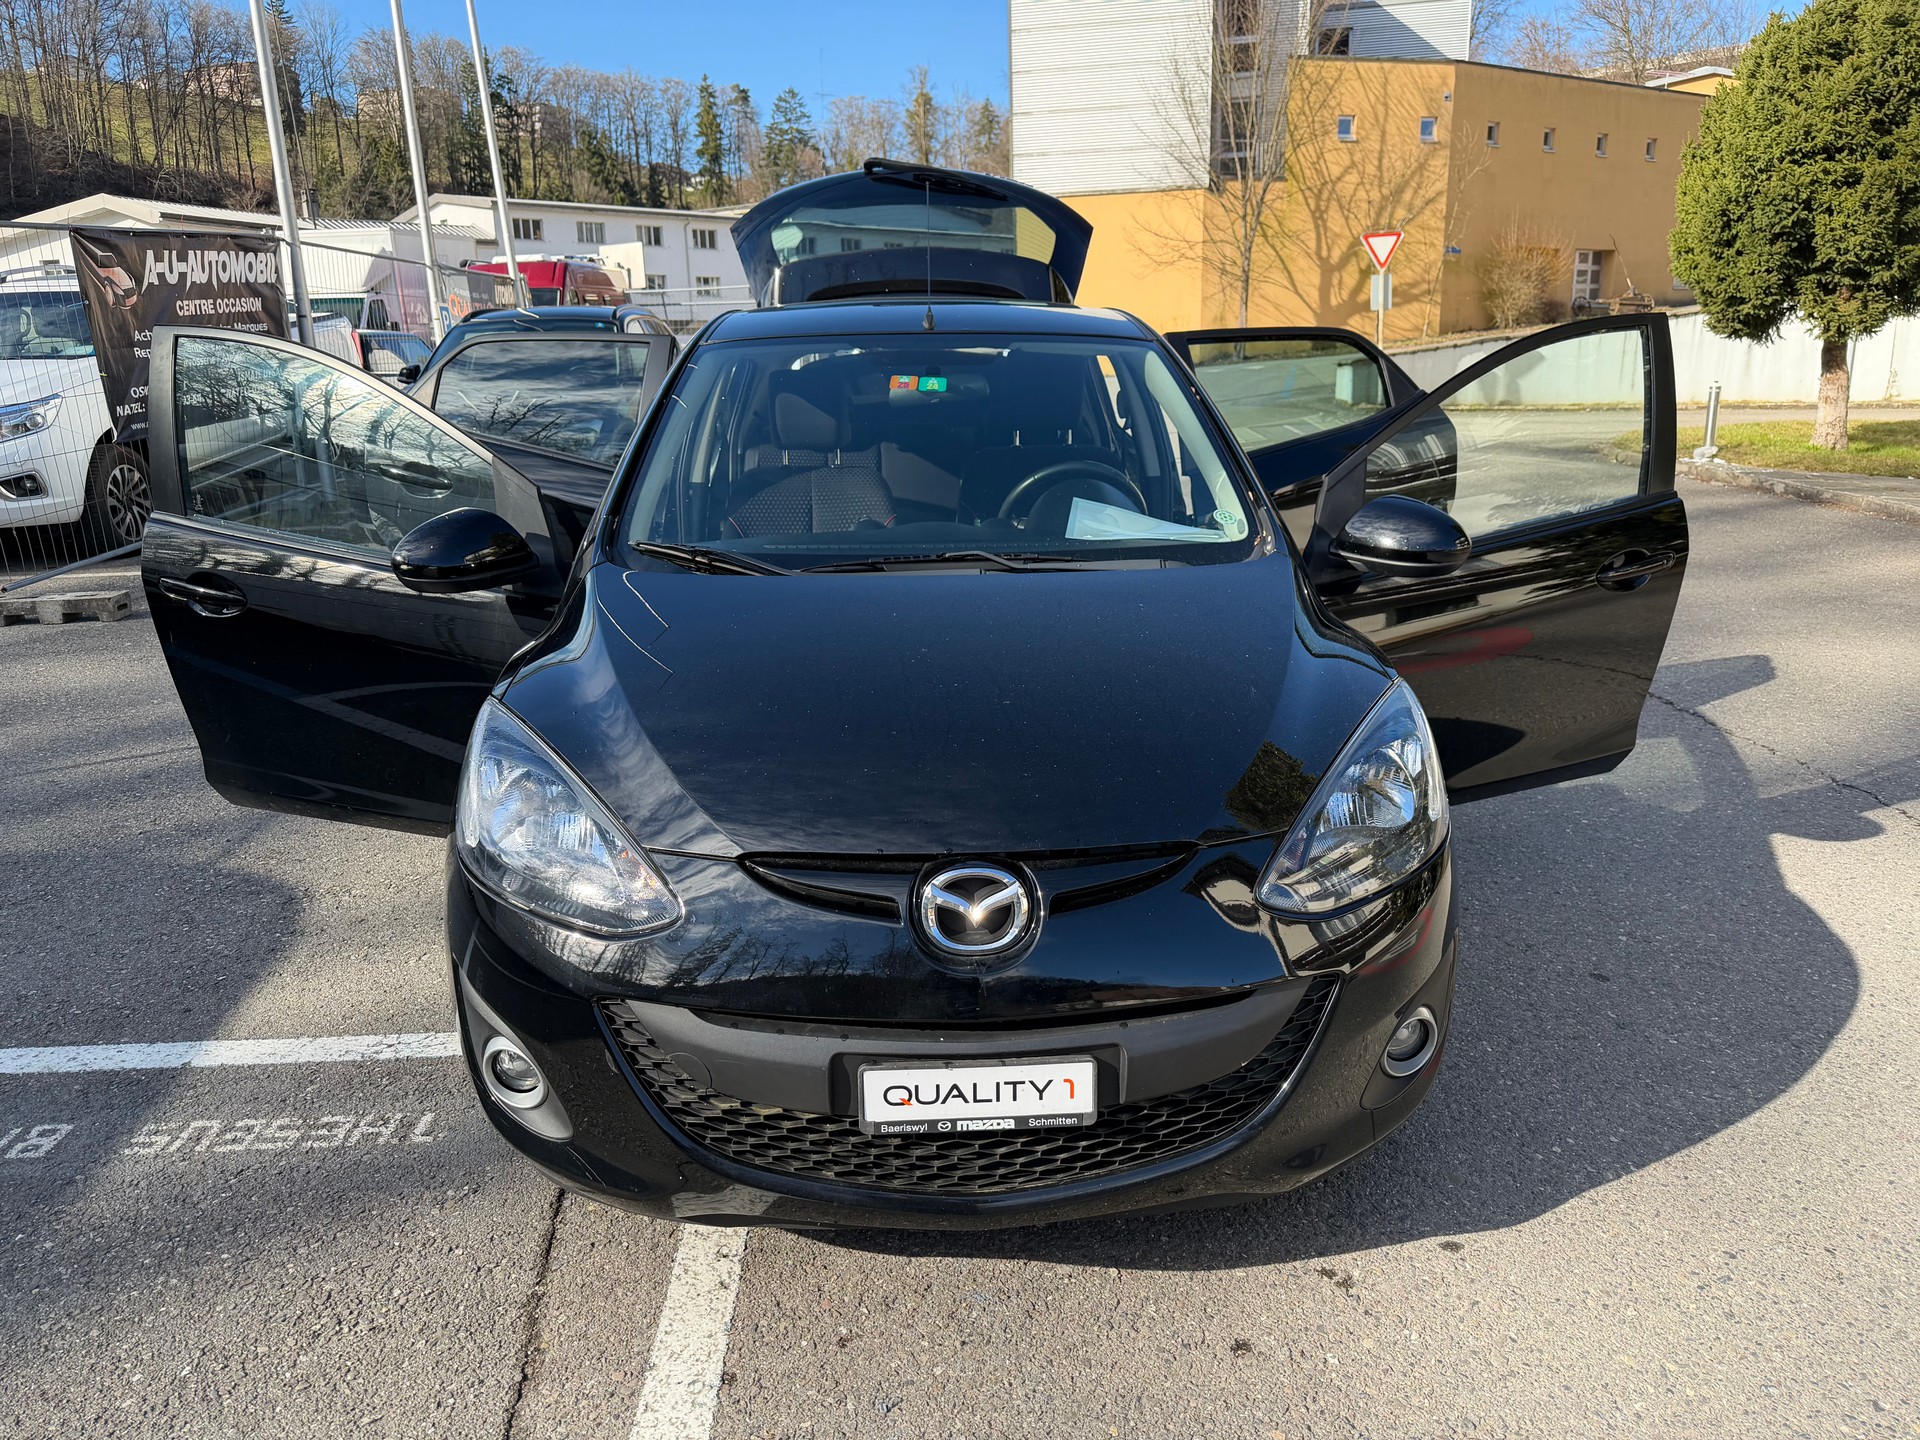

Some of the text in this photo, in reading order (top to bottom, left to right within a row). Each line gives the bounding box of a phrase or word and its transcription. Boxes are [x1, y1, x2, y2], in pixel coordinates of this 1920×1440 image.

[175, 297, 262, 317] CENTRE OCCASION
[233, 322, 268, 332] Marques
[116, 401, 146, 417] NATEL:
[883, 1078, 1075, 1106] QUALITY 1
[881, 1123, 928, 1134] Baeriswyl
[1028, 1116, 1078, 1127] Schmitten
